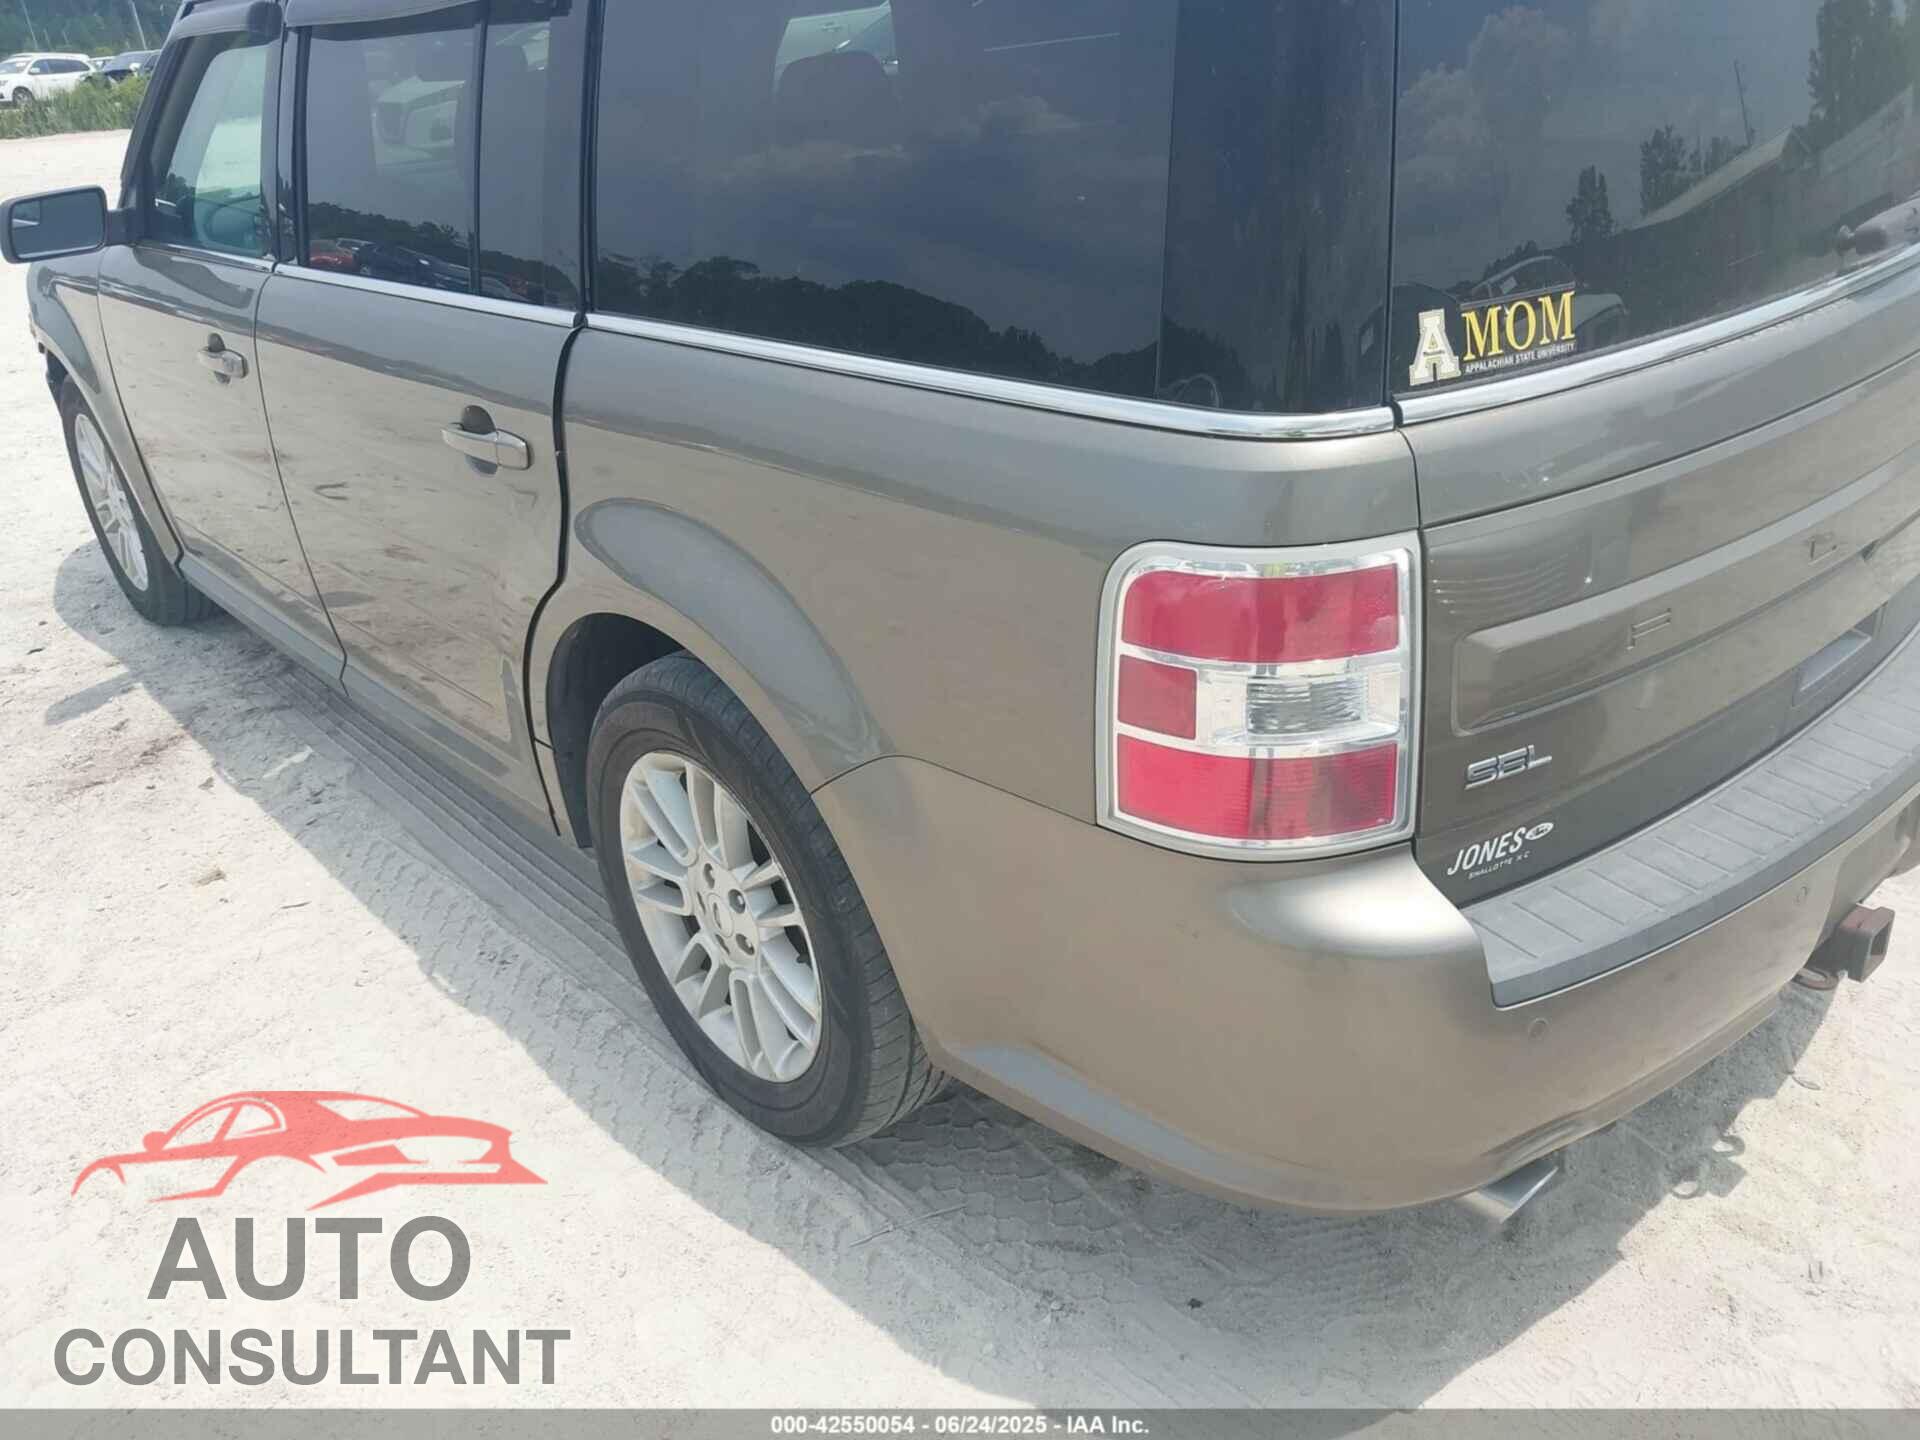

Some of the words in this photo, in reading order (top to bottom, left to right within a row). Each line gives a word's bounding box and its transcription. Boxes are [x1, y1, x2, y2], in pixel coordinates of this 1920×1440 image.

[1461, 291, 1576, 361] MOM
[1465, 356, 1514, 373] APPALACHIAN
[1516, 349, 1535, 364] STATE
[1536, 342, 1576, 360] UNIVERSITY
[1464, 744, 1553, 790] SEL
[1447, 827, 1527, 876] JONES
